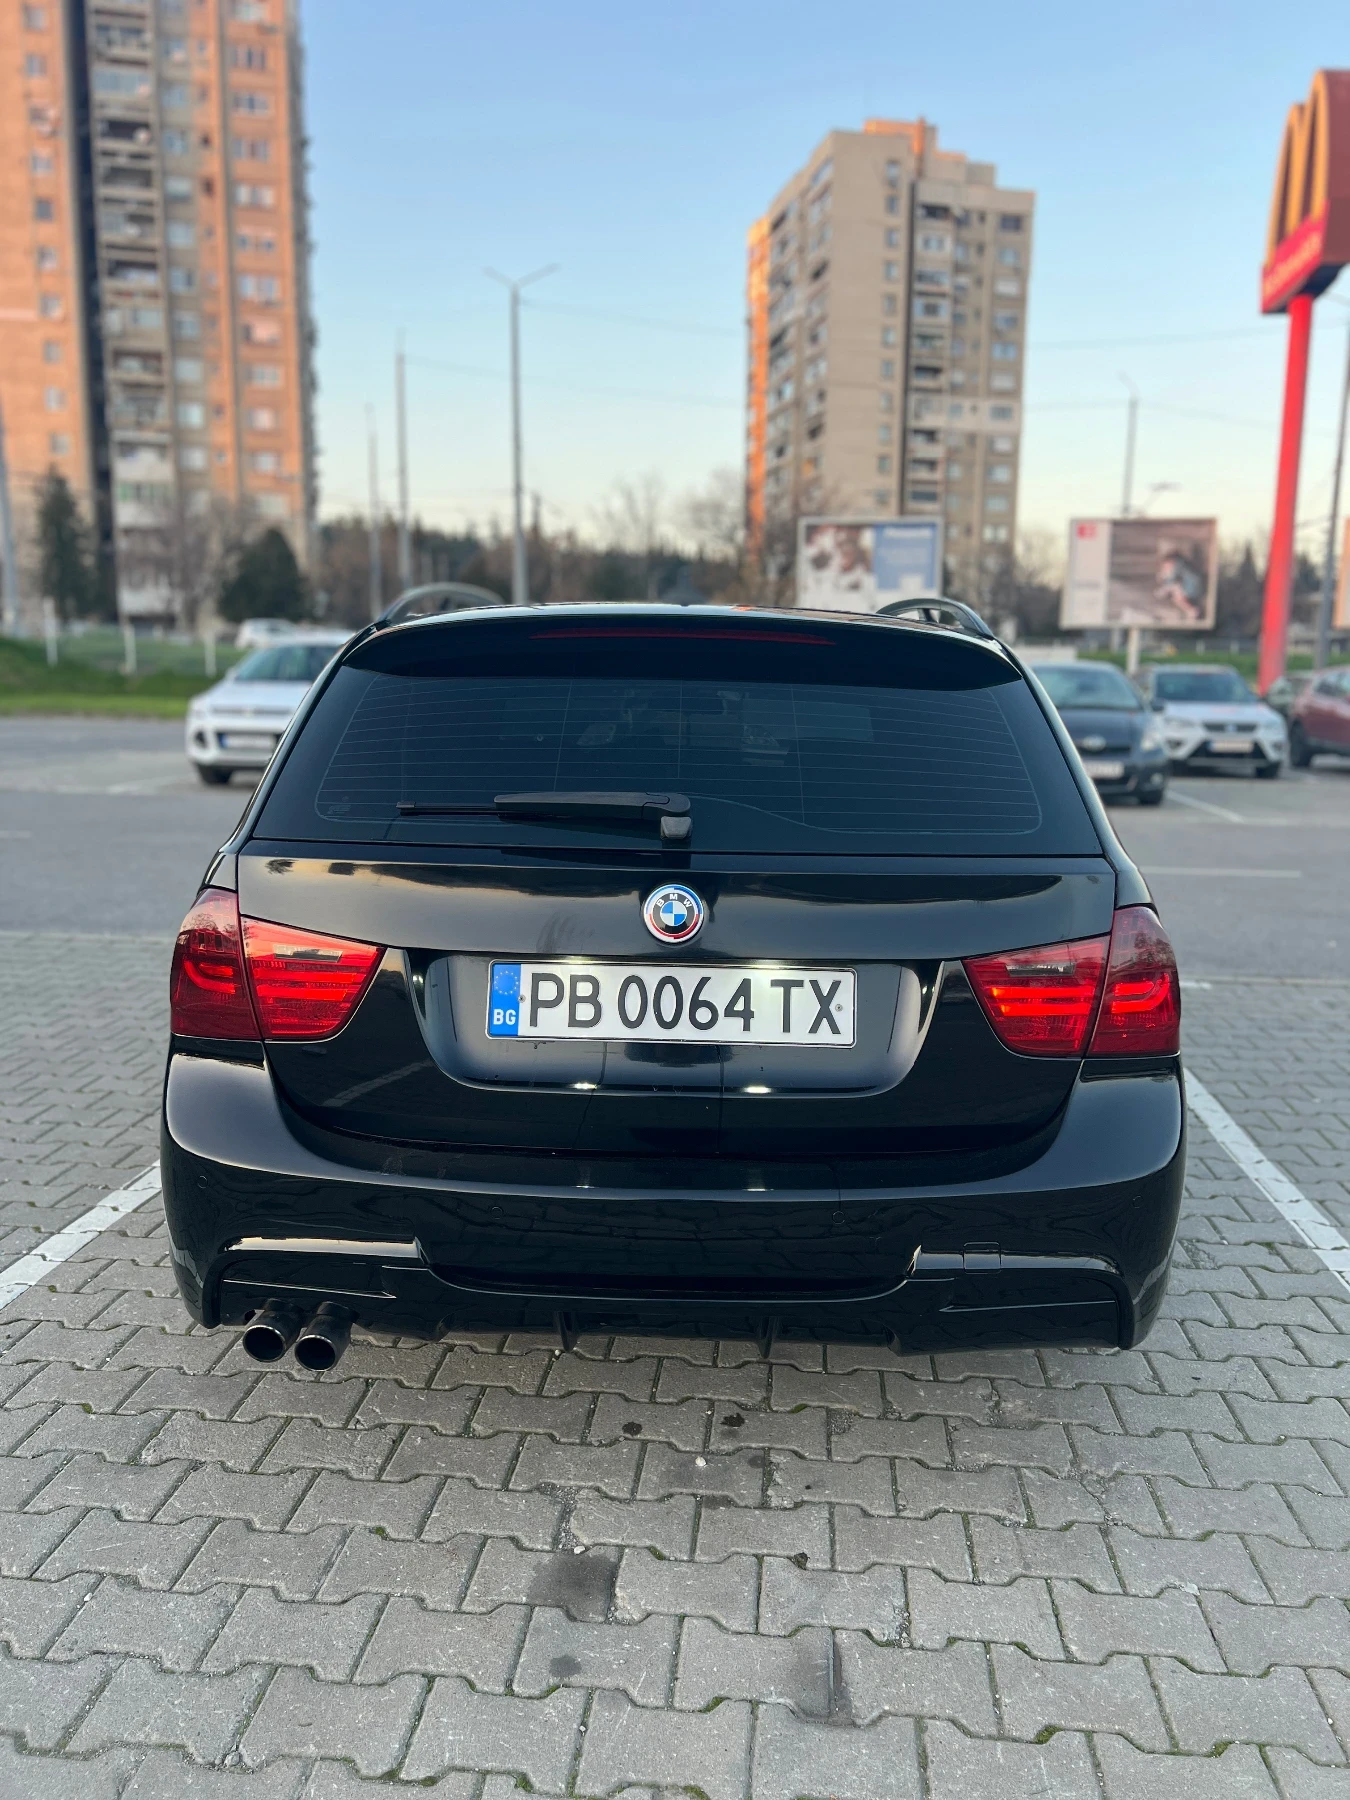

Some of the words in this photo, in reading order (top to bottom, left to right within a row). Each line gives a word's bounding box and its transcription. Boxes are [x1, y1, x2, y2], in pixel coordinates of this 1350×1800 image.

[655, 893, 693, 908] BMW
[529, 972, 602, 1028] PB
[617, 974, 755, 1033] 0064
[770, 979, 842, 1035] TX
[493, 1008, 517, 1025] BG
